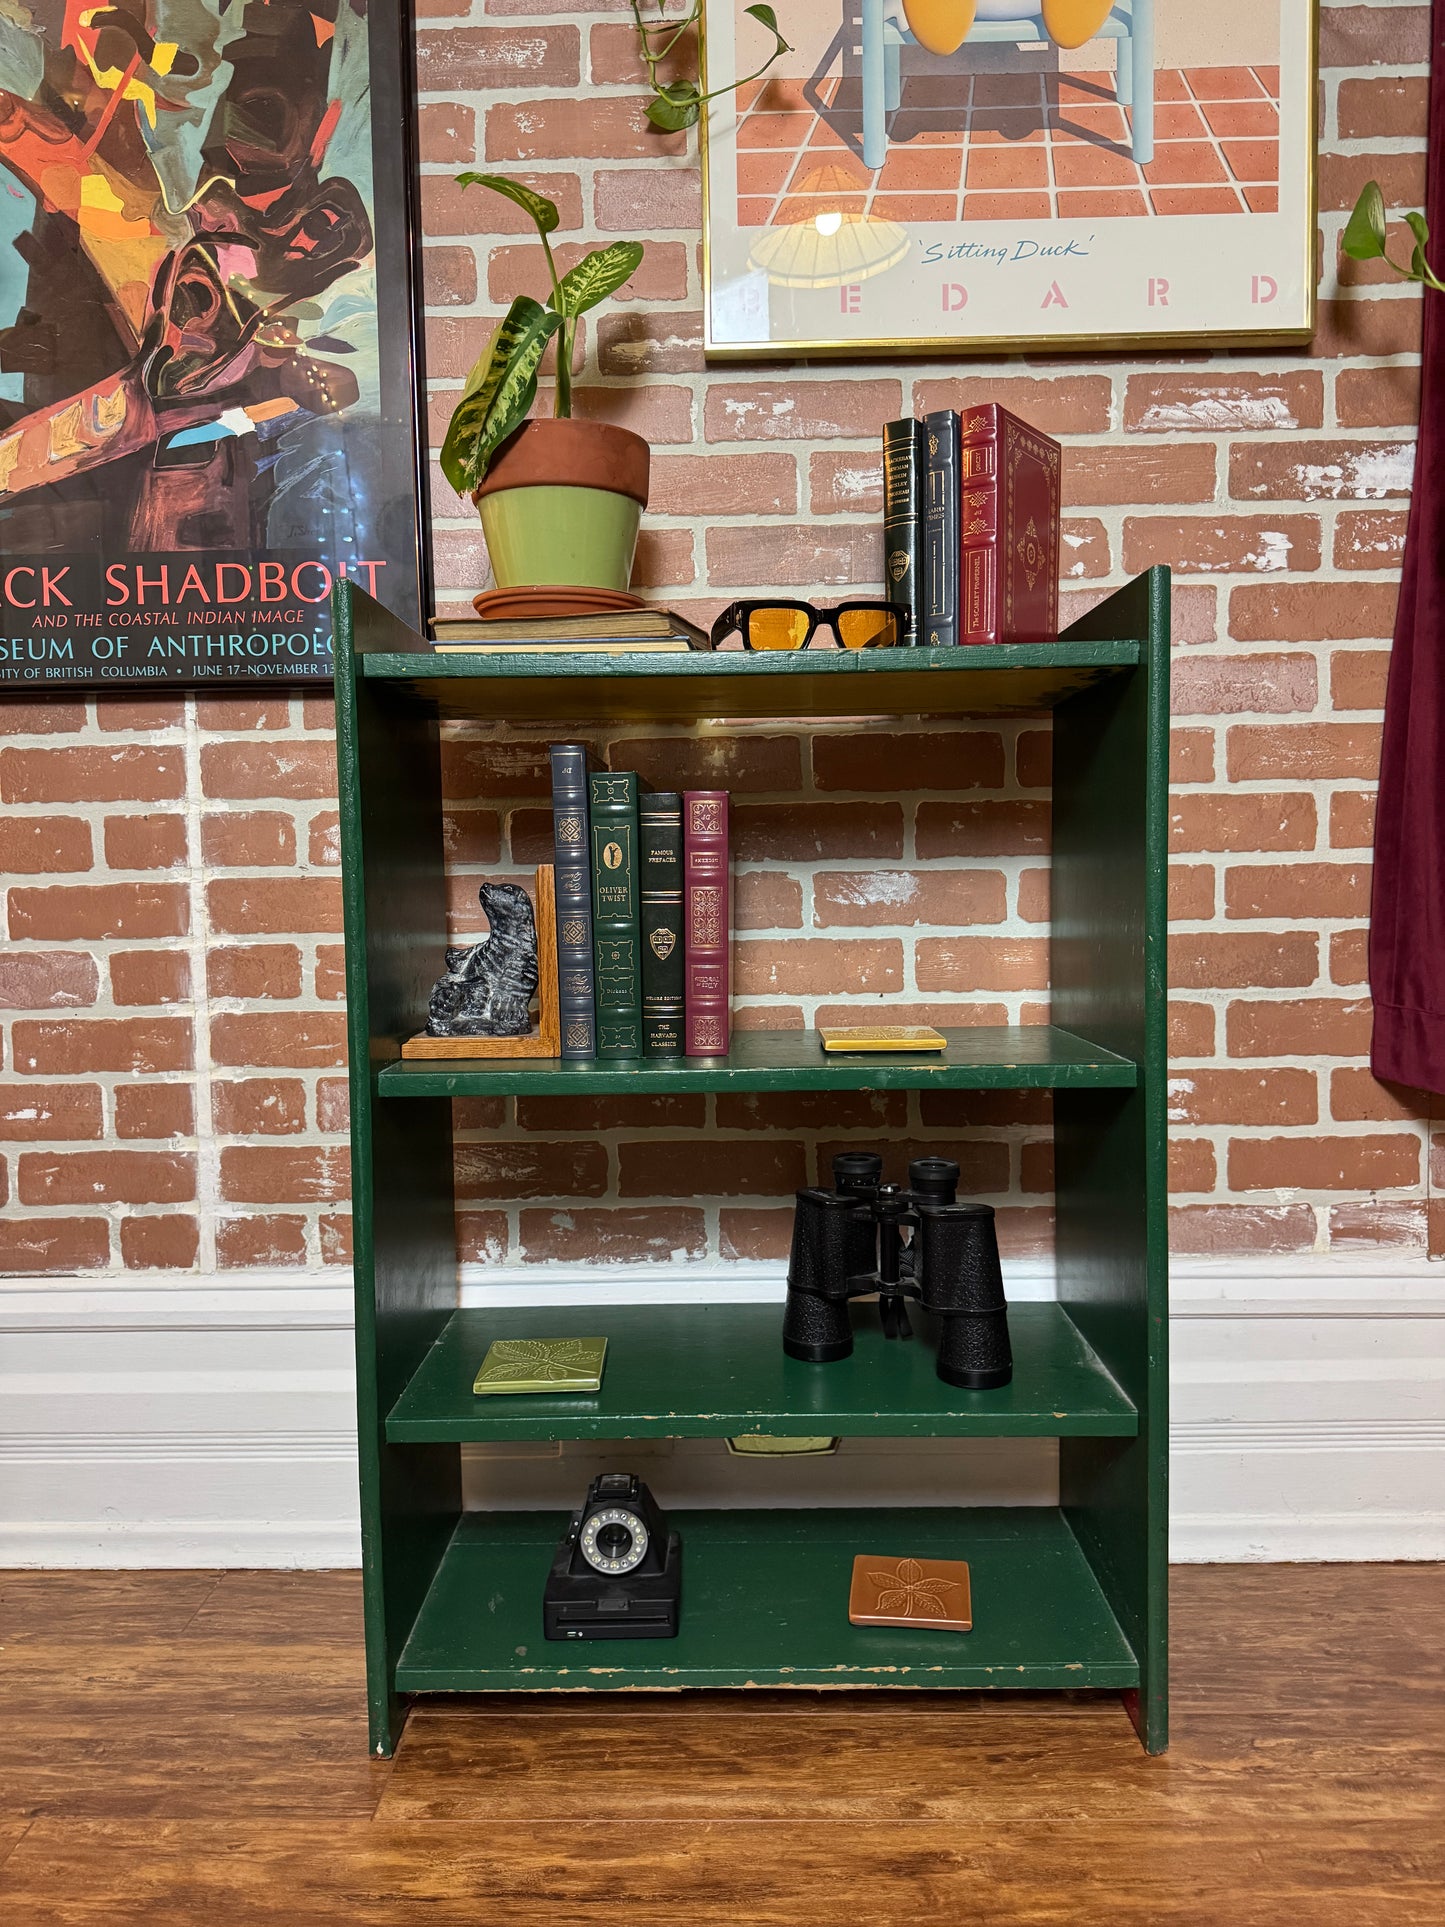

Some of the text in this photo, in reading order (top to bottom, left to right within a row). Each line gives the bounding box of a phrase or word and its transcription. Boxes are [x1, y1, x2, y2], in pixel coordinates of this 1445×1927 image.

[0, 566, 73, 608] CK
[31, 609, 305, 628] AND THE COASTAL INDIAN IMAGE
[91, 636, 129, 660] OF
[0, 667, 20, 679] ITY
[23, 667, 41, 679] OF
[45, 666, 93, 678] BRITISH
[101, 665, 168, 677] COLUMBIA
[192, 664, 223, 677] JUNE
[599, 886, 628, 894] OLIVER
[601, 894, 626, 902] TWIST
